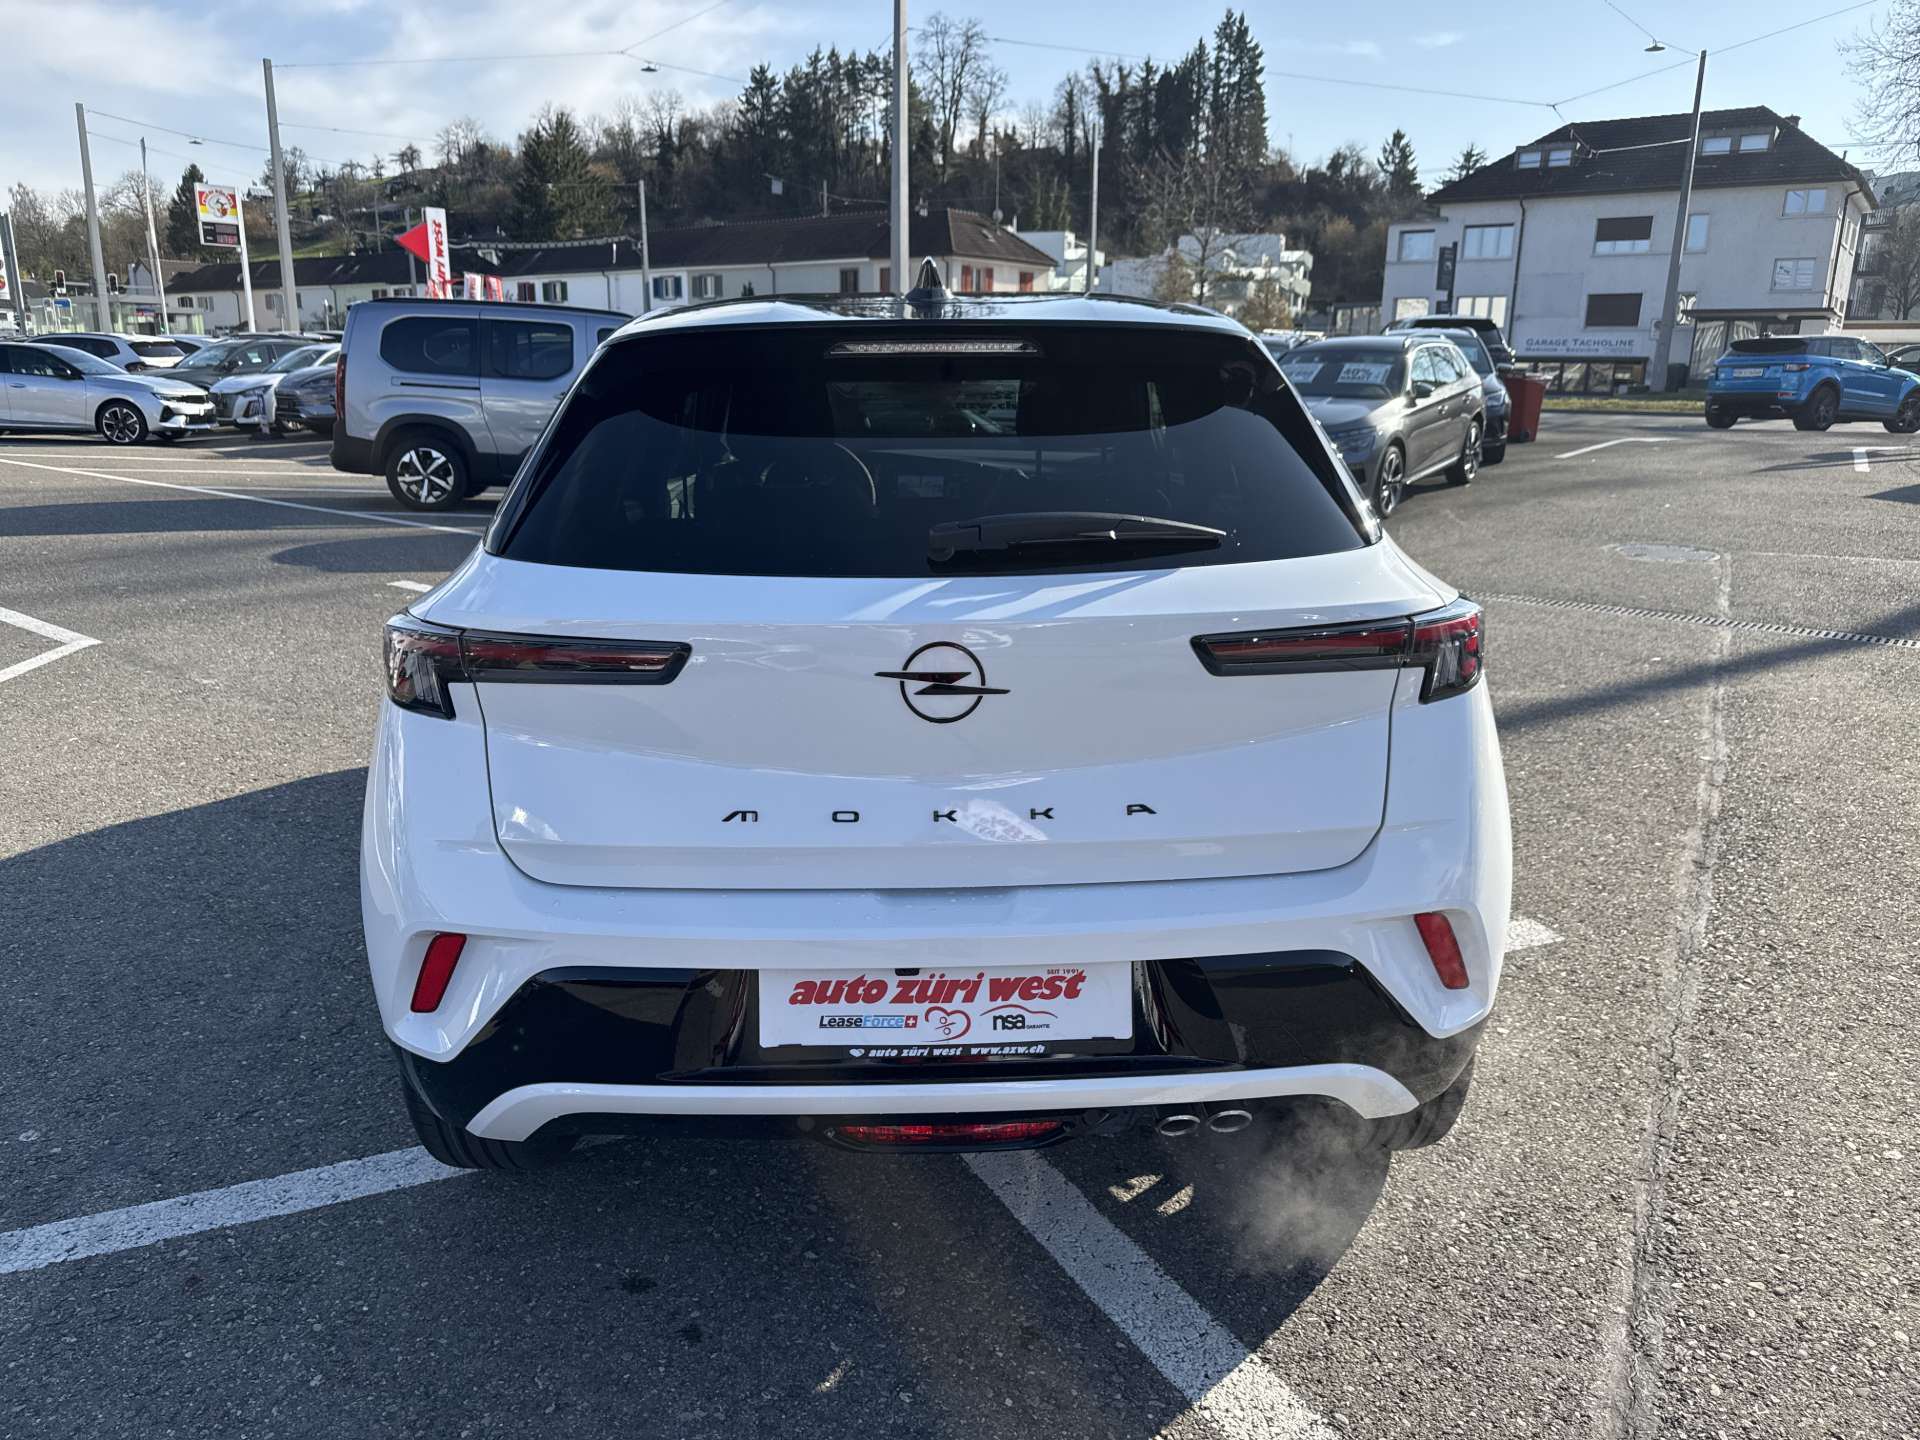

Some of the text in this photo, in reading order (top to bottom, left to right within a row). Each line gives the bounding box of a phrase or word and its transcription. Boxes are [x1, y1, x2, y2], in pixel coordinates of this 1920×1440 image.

[1525, 338, 1635, 347] GARAGE TACHOLINE
[721, 804, 1157, 823] MOKKA
[788, 970, 1087, 1006] auto züri west
[819, 1015, 904, 1028] LeaseForce
[993, 1014, 1026, 1031] nsa
[868, 1047, 898, 1057] auto
[901, 1046, 929, 1057] züri
[933, 1046, 963, 1057] west
